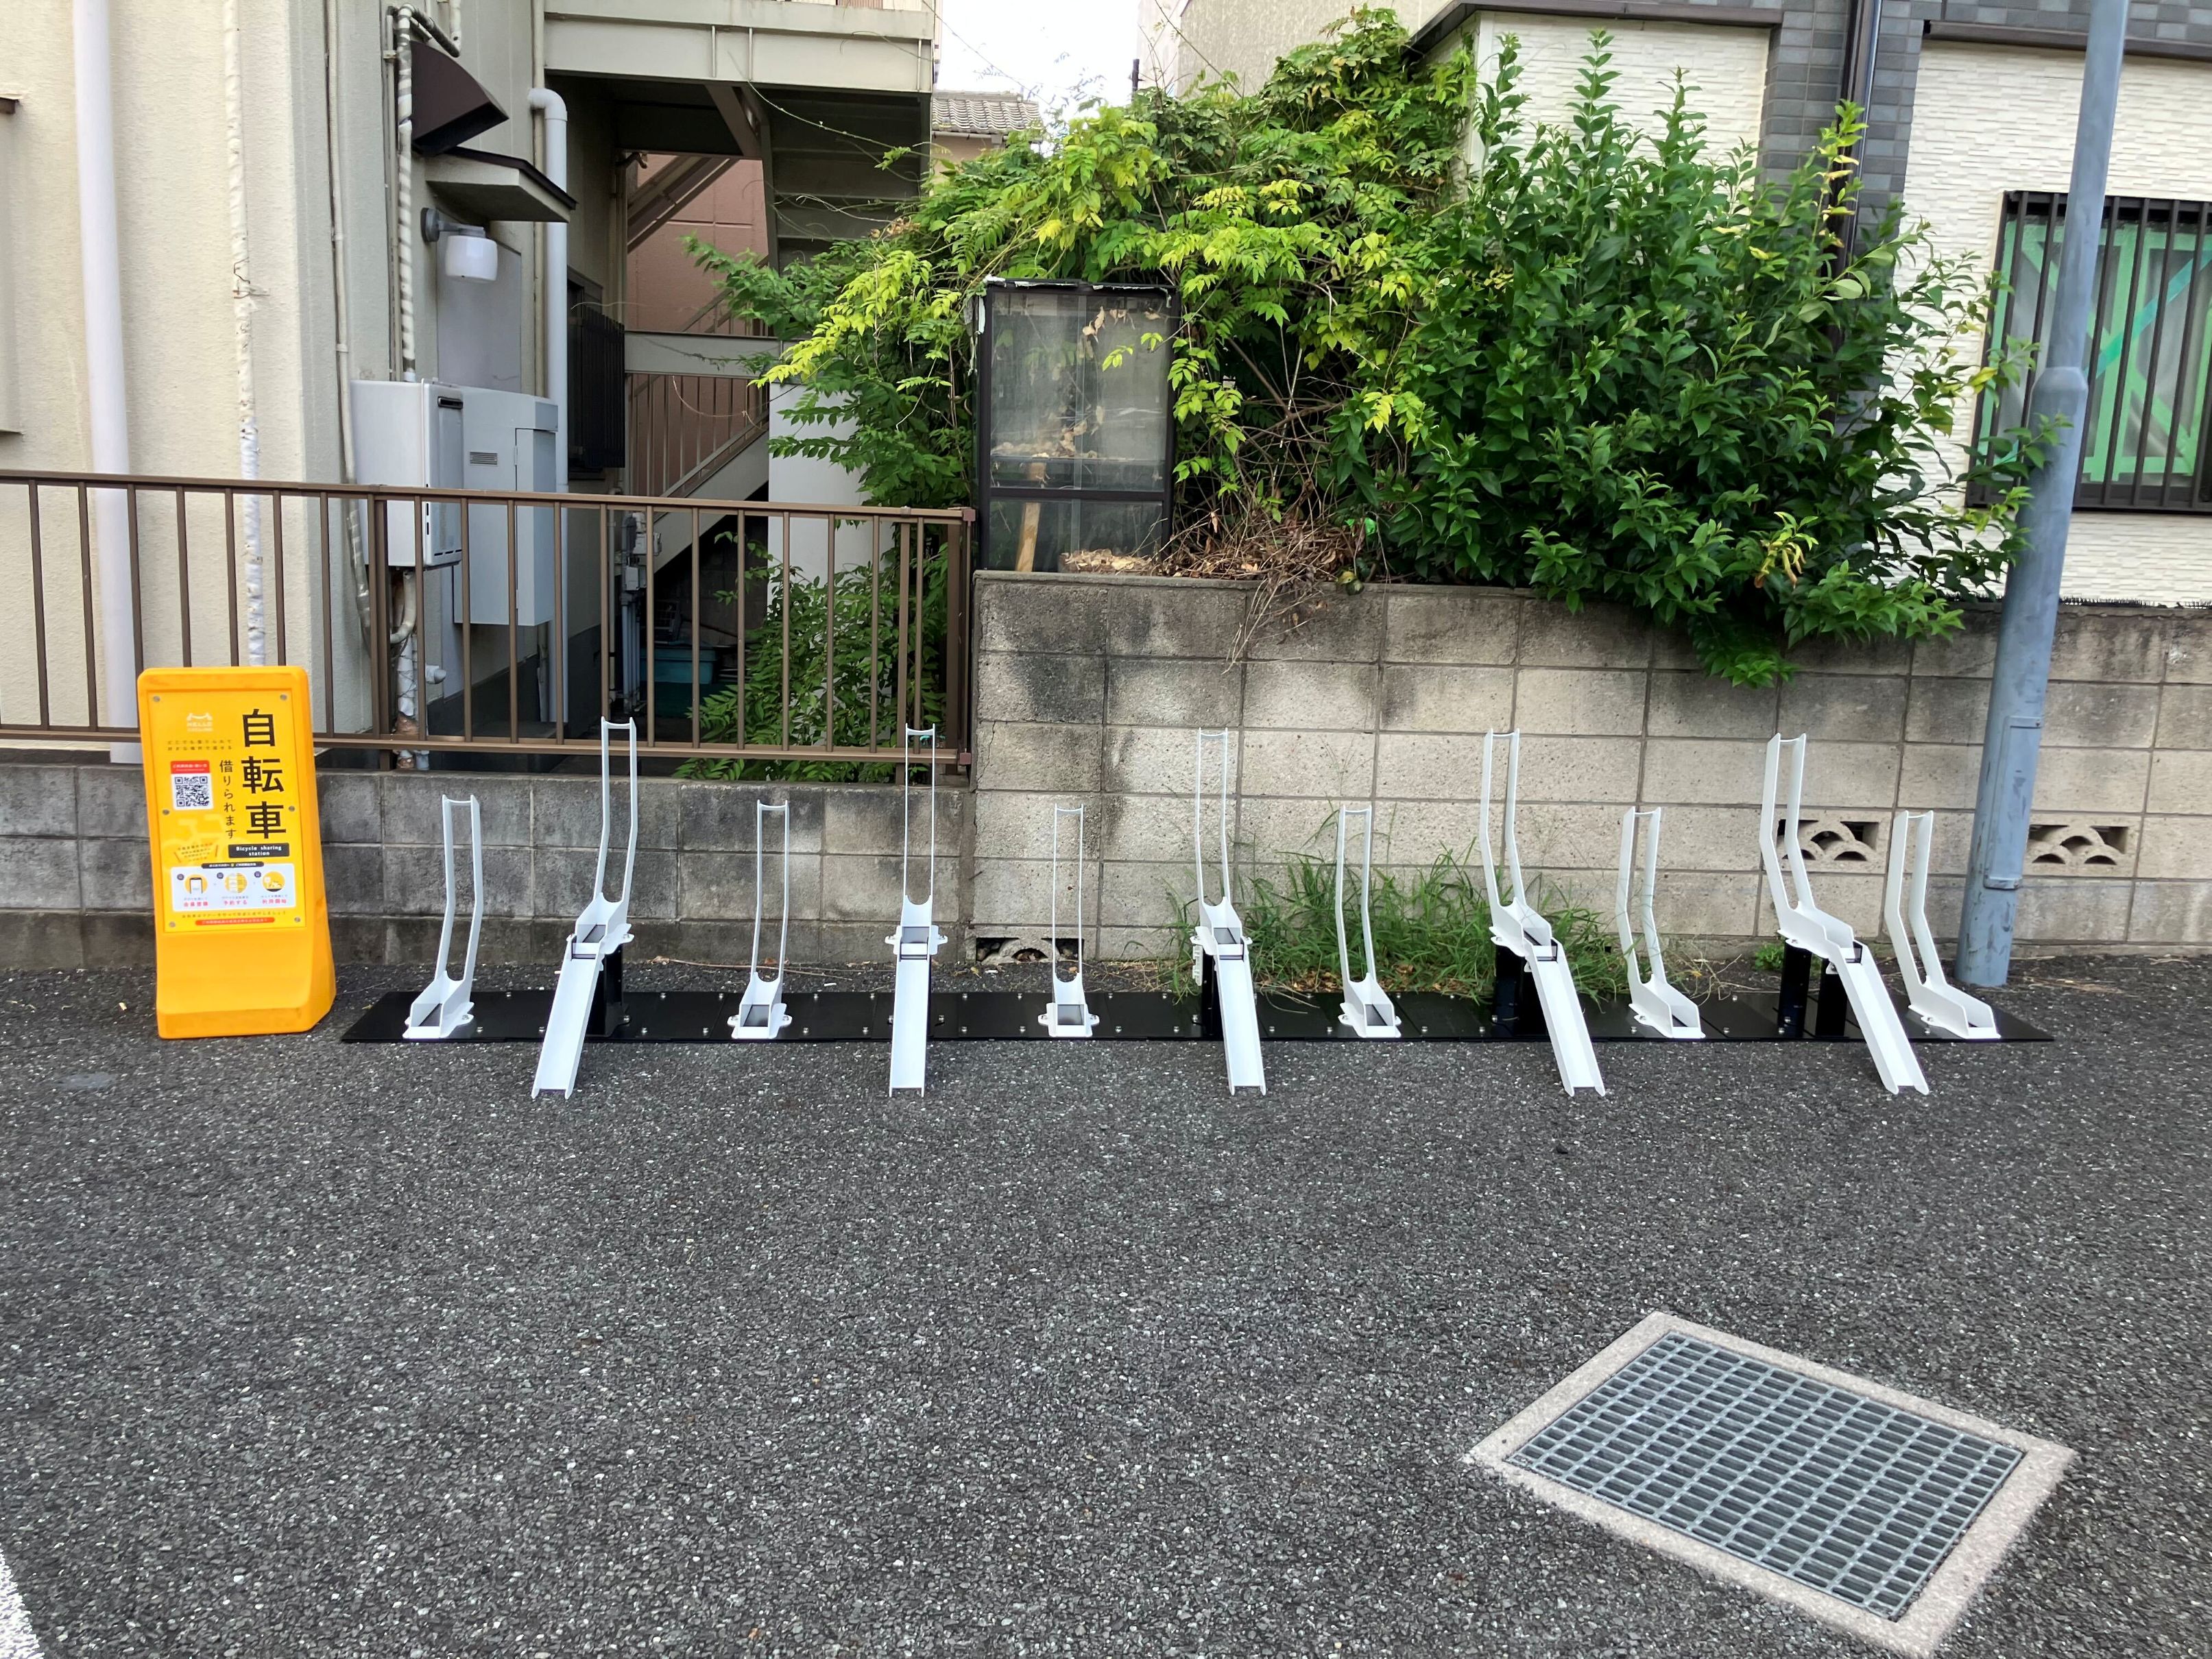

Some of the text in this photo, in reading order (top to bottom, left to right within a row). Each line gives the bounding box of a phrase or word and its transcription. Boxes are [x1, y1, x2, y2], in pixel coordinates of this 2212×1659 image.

[219, 760, 236, 838] 借りられます
[241, 709, 286, 838] 自転車
